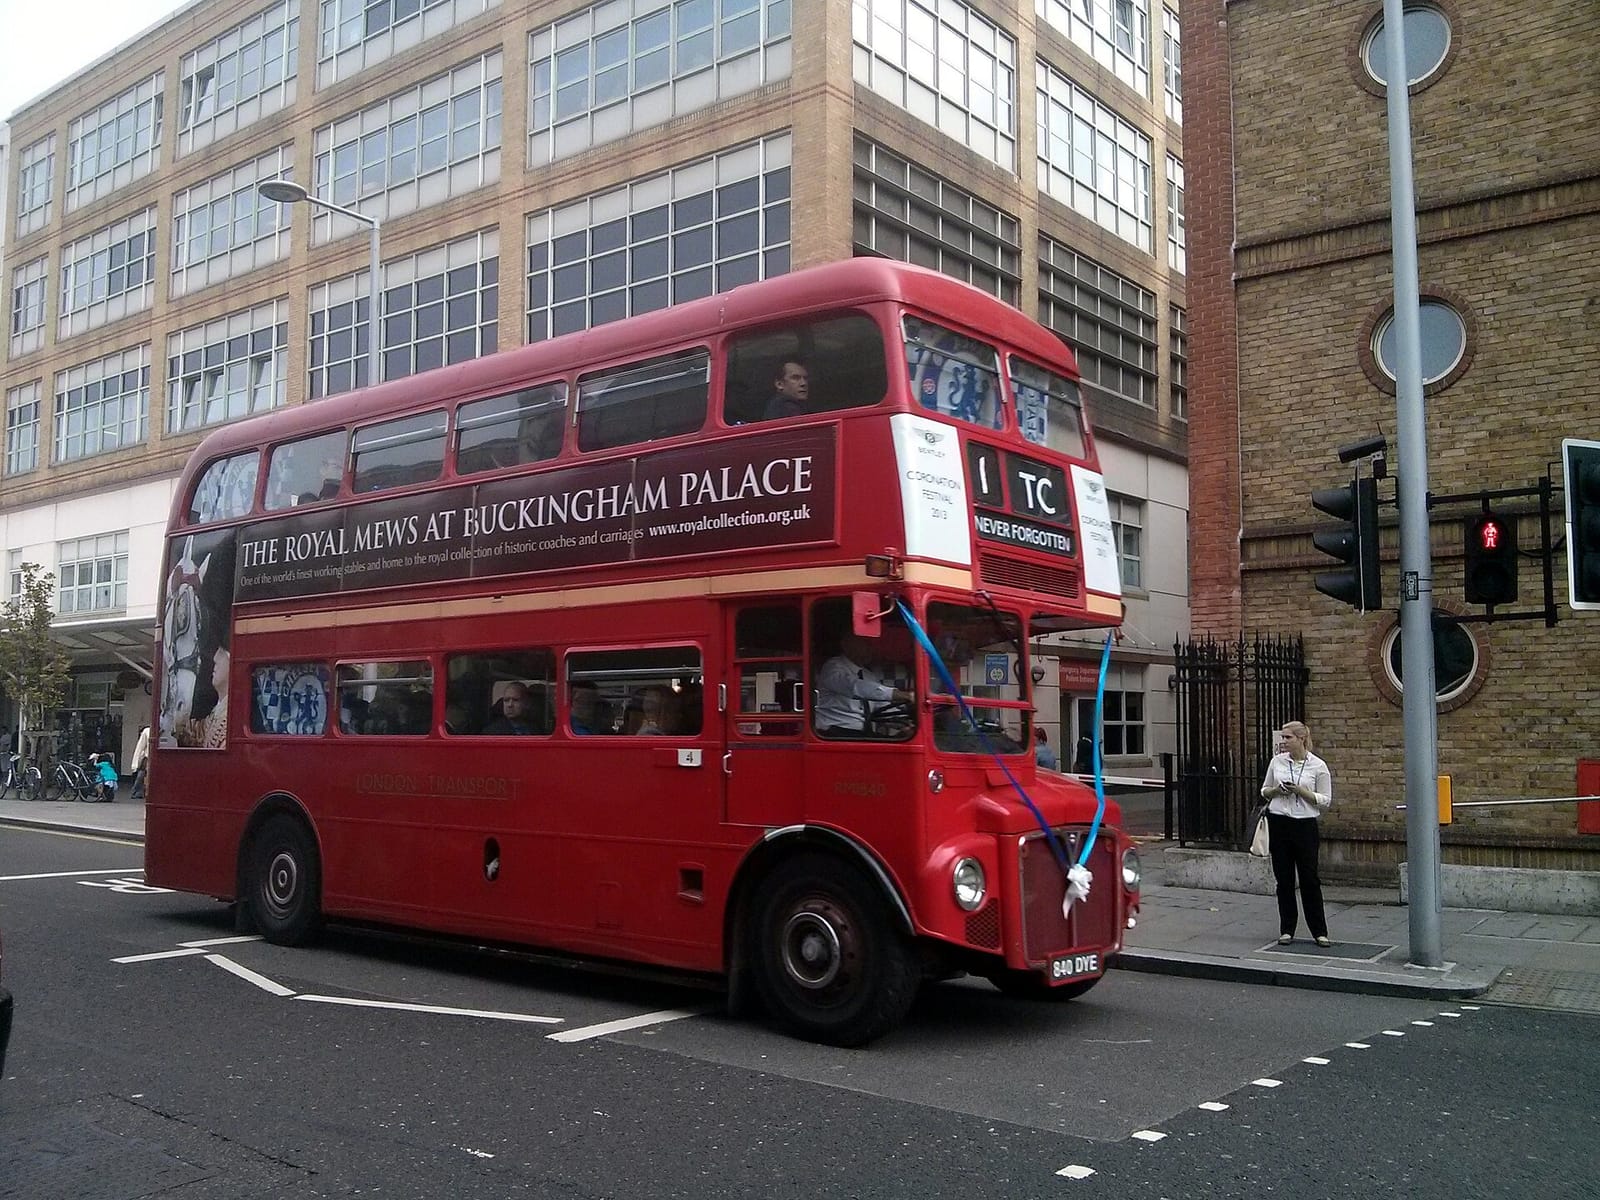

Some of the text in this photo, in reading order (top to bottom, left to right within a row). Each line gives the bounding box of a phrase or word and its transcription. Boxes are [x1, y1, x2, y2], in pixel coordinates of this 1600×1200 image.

[906, 470, 961, 490] CORONATION
[922, 488, 953, 505] FESTIVAL
[1018, 471, 1056, 515] TC
[242, 456, 813, 568] THE ROYAL MEWS AT BUCKINGHAM PALACE
[931, 507, 948, 520] 2013
[241, 504, 811, 587] One of the world's finest working stables and home to the royal collection of historic coaches and carriages www.royalcollection.org.uk
[974, 515, 1010, 538] NEVER
[1011, 524, 1070, 552] FORGOTTEN
[686, 751, 693, 763] 4
[356, 773, 521, 800] LONDON TRANSPORT
[1053, 954, 1097, 977] 840 DYE
